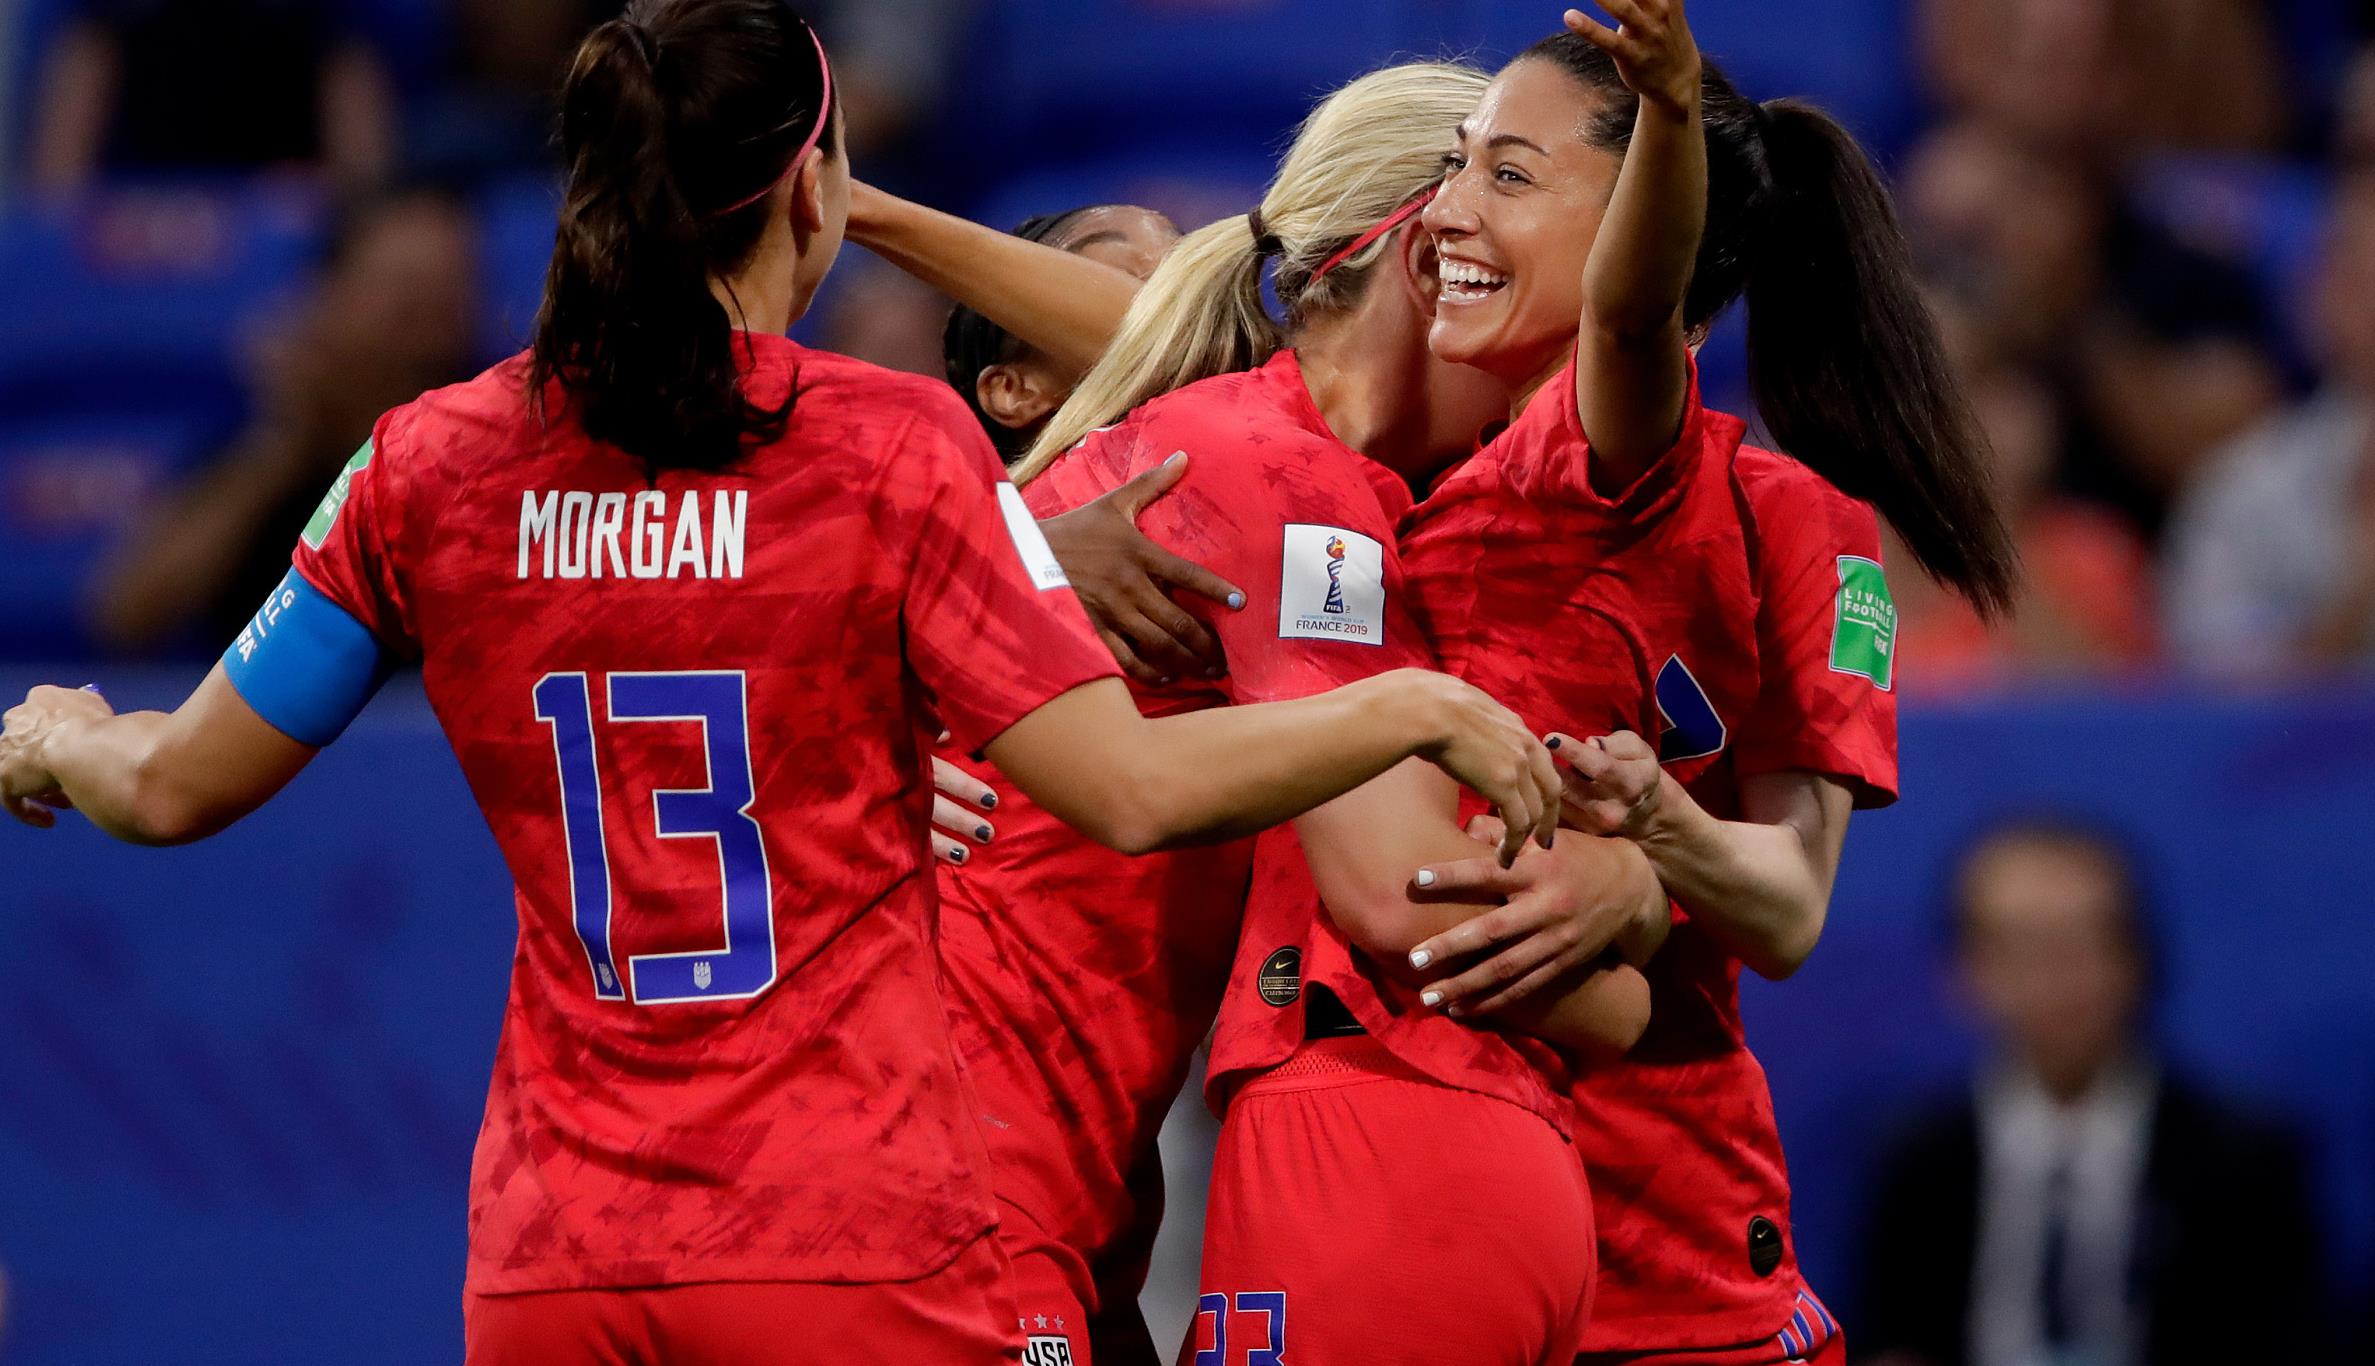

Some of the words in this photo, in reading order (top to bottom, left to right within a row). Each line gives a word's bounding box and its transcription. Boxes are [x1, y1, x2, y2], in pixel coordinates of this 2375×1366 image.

[517, 490, 748, 579] MORGAN
[1326, 604, 1342, 612] FIFA
[1844, 588, 1892, 616] LIVING
[1296, 619, 1342, 632] FRANCE
[1343, 623, 1368, 635] 2019
[532, 670, 777, 1005] 13
[1024, 1341, 1072, 1366] USA
